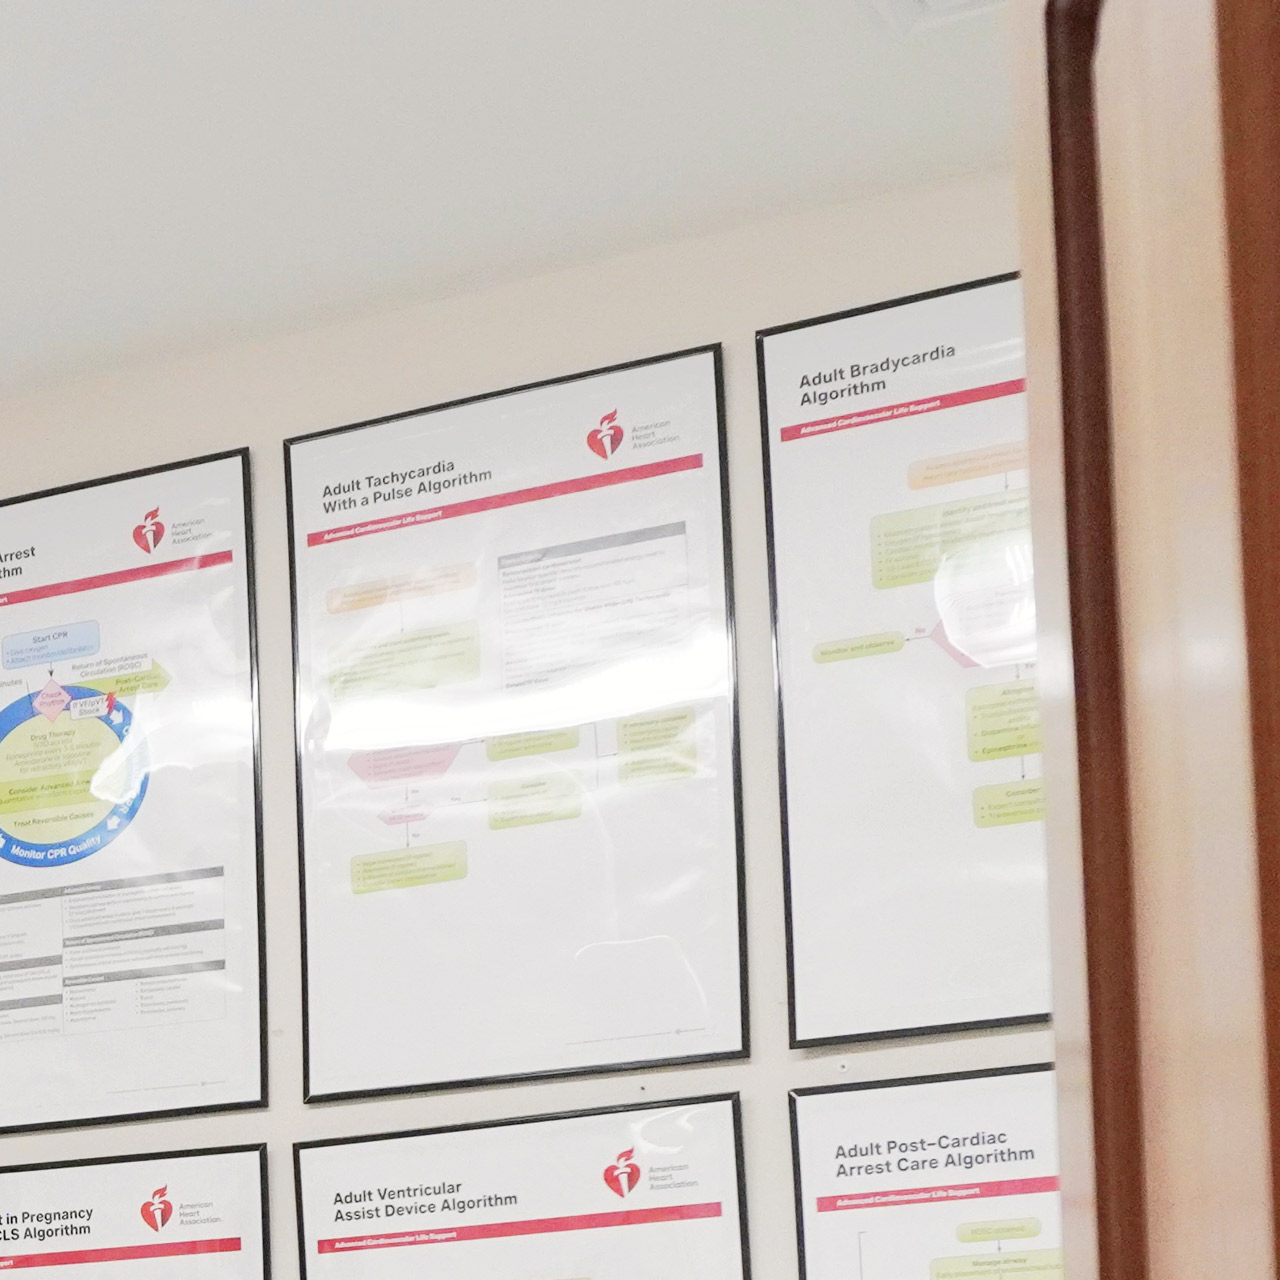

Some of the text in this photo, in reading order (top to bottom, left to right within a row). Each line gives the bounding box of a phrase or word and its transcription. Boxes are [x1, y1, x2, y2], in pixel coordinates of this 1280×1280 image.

[800, 346, 955, 388] Adult Bradycardia
[801, 379, 886, 406] Algorithm
[323, 462, 454, 498] Adult Tachycardia
[323, 471, 492, 514] With a Pulse Algorithm
[172, 527, 192, 536] Heart
[33, 630, 68, 643] Start CPR
[11, 834, 101, 860] Monitor CPR Quality
[836, 1132, 1007, 1159] Adult Post-Cardiac
[837, 1147, 1035, 1177] Arrest Care Algorithm
[180, 1201, 213, 1209] American
[334, 1183, 462, 1205] Adult Ventricular
[7, 1214, 17, 1225] in
[22, 1210, 93, 1225] Pregnancy
[180, 1209, 200, 1217] Heart
[335, 1195, 517, 1222] Assist Device Algorithm
[24, 1224, 91, 1241] Algorithm
